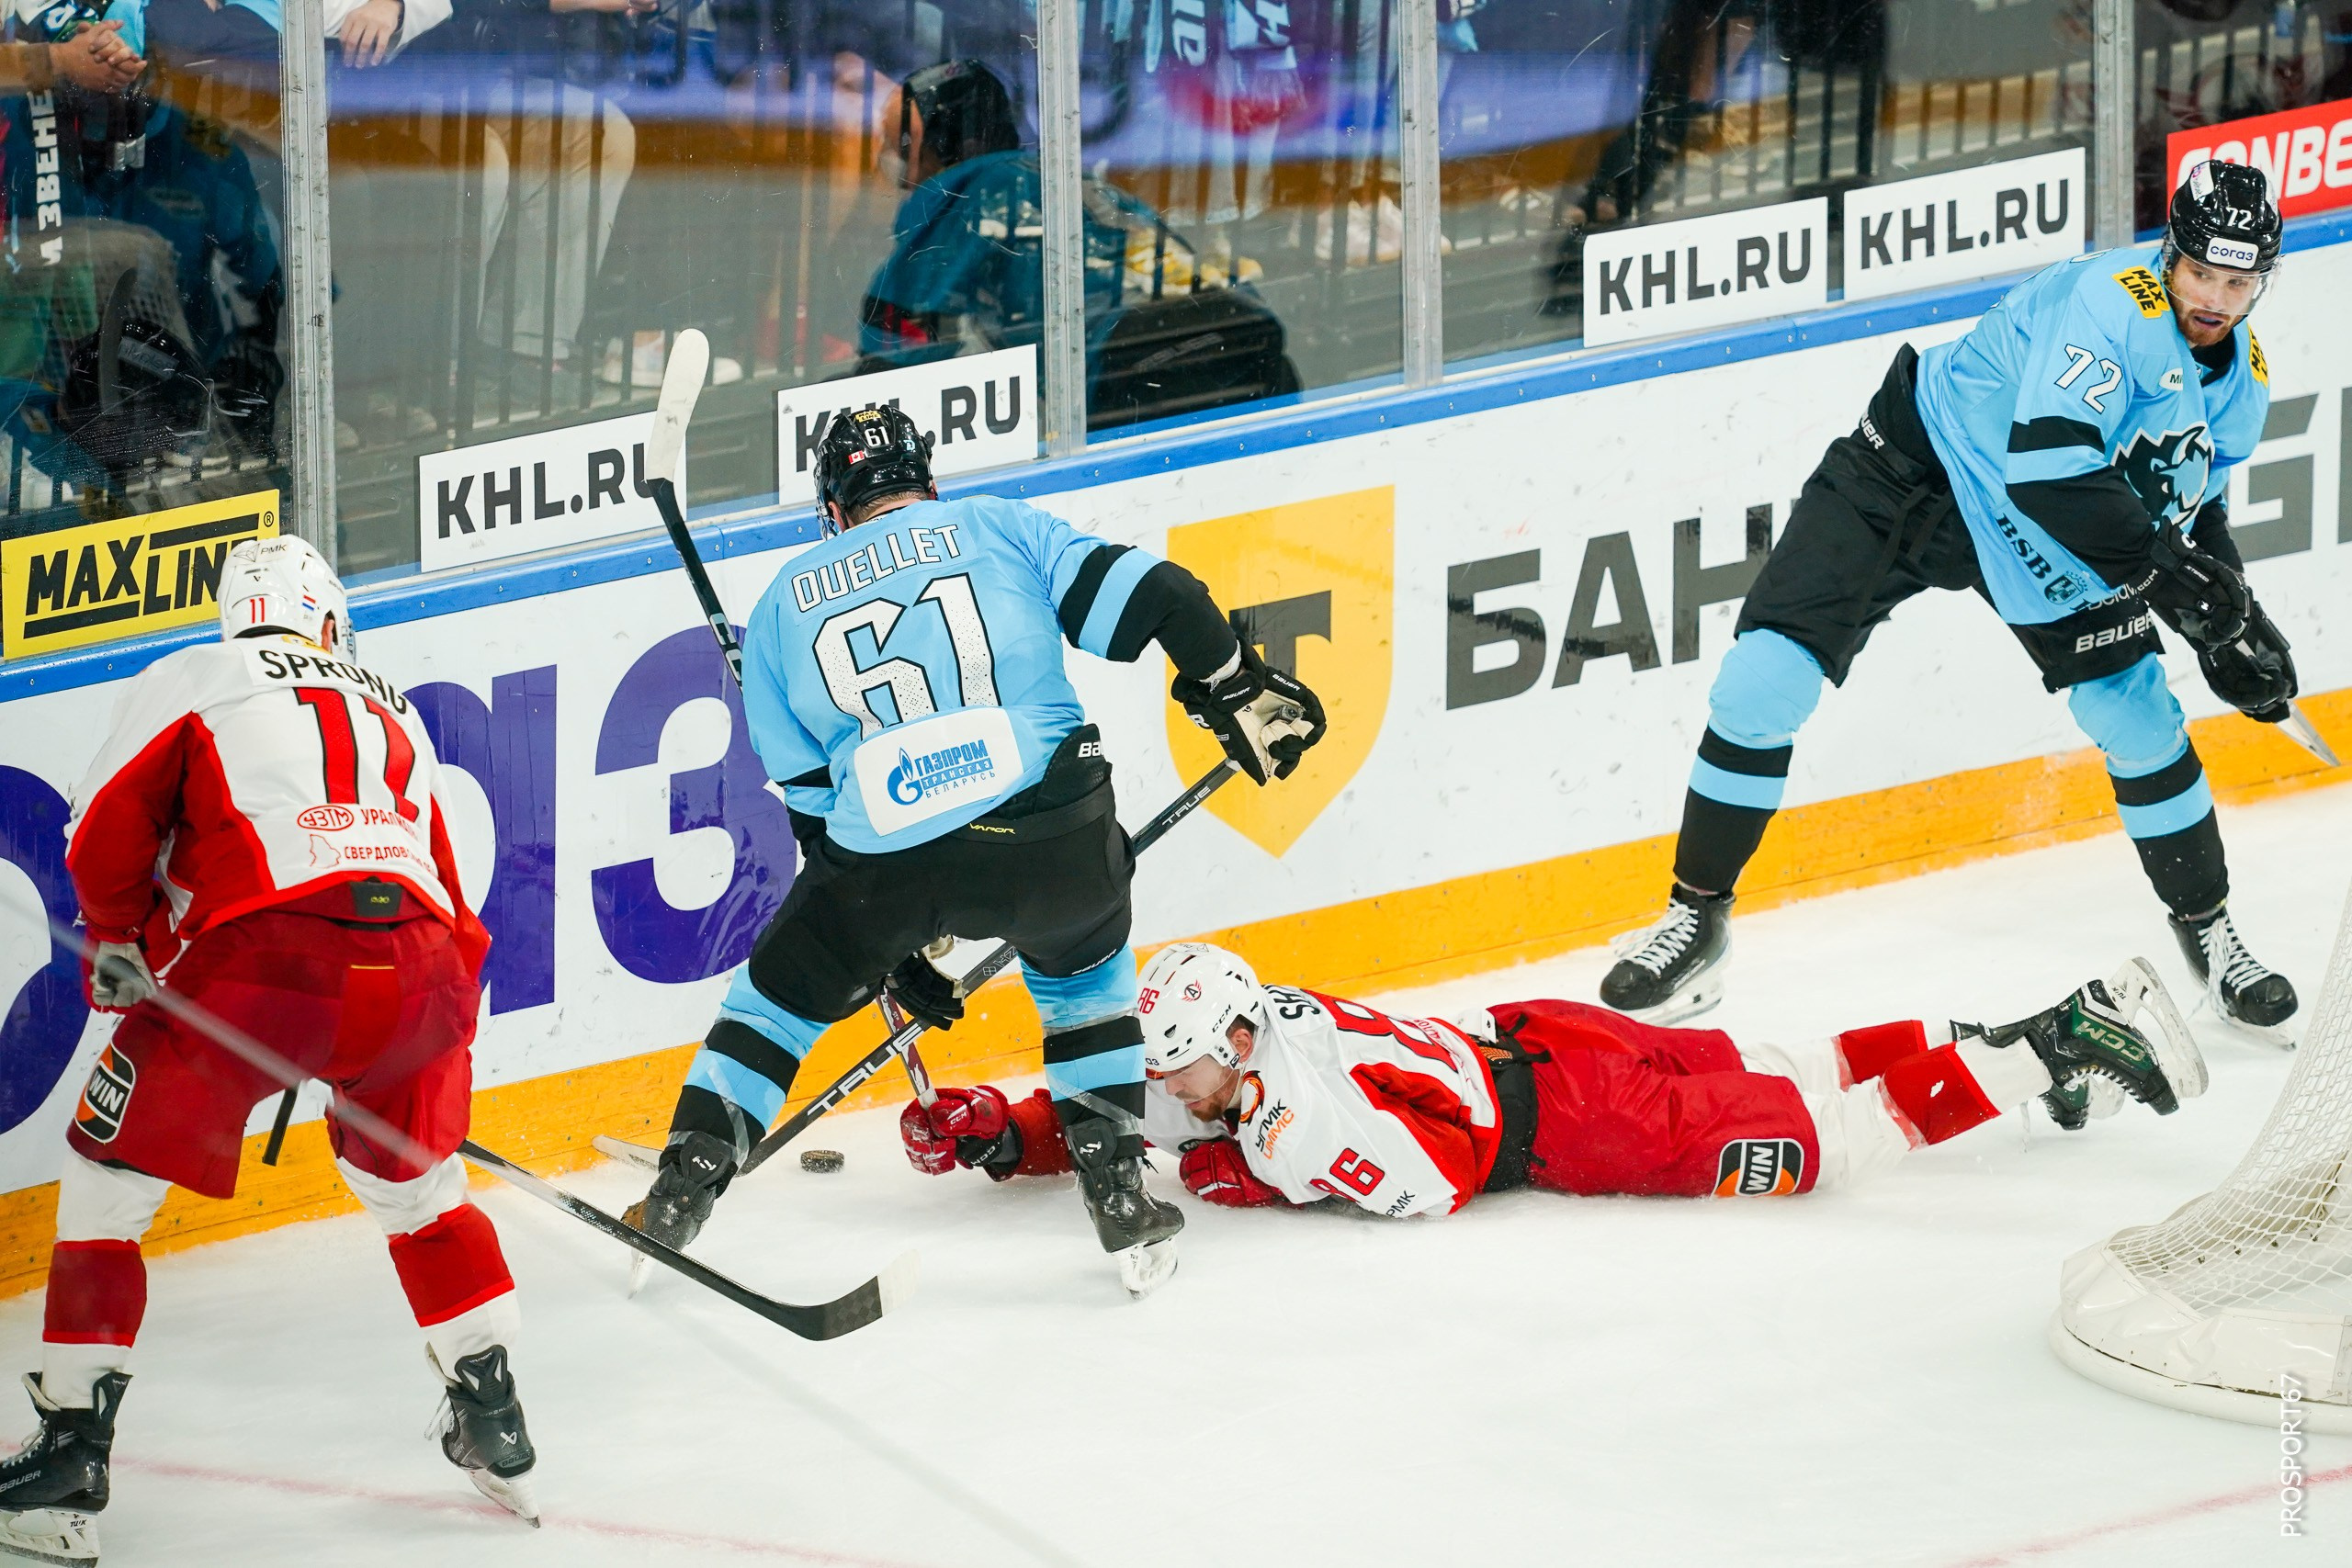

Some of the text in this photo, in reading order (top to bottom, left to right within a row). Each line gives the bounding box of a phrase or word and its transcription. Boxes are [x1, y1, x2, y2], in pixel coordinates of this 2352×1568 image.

[1861, 178, 2068, 270] KHL.RU
[2225, 207, 2253, 231] 72
[1600, 228, 1811, 316] KHL.RU
[2210, 243, 2254, 262] согаз
[2120, 276, 2156, 310] LINE
[2132, 269, 2166, 304] MAX
[2053, 343, 2123, 415] 72
[796, 376, 1020, 472] K.RU
[865, 425, 890, 447] 61
[1995, 513, 2052, 580] BSB
[25, 535, 257, 616] MAXLIN
[791, 524, 960, 614] OUELLET
[250, 597, 266, 624] 11
[1446, 498, 1802, 711] БАН
[812, 571, 1002, 741] 61
[259, 649, 407, 715] SPRONG
[914, 739, 989, 777] ГАЗПРОМ
[923, 760, 991, 788] ТРАНСГАЗ
[925, 771, 996, 798] БЕЛАРУСЬ
[1161, 785, 1211, 827] TRUE
[969, 822, 1016, 835] VAPOR
[1212, 1004, 1232, 1032] CCM
[2075, 1021, 2147, 1062] CCM
[807, 1022, 925, 1116] TRUE
[950, 1111, 967, 1125] CCM
[1255, 1099, 1287, 1152] УГМК
[1263, 1109, 1295, 1159] UMMC
[1746, 1145, 1774, 1191] WIN
